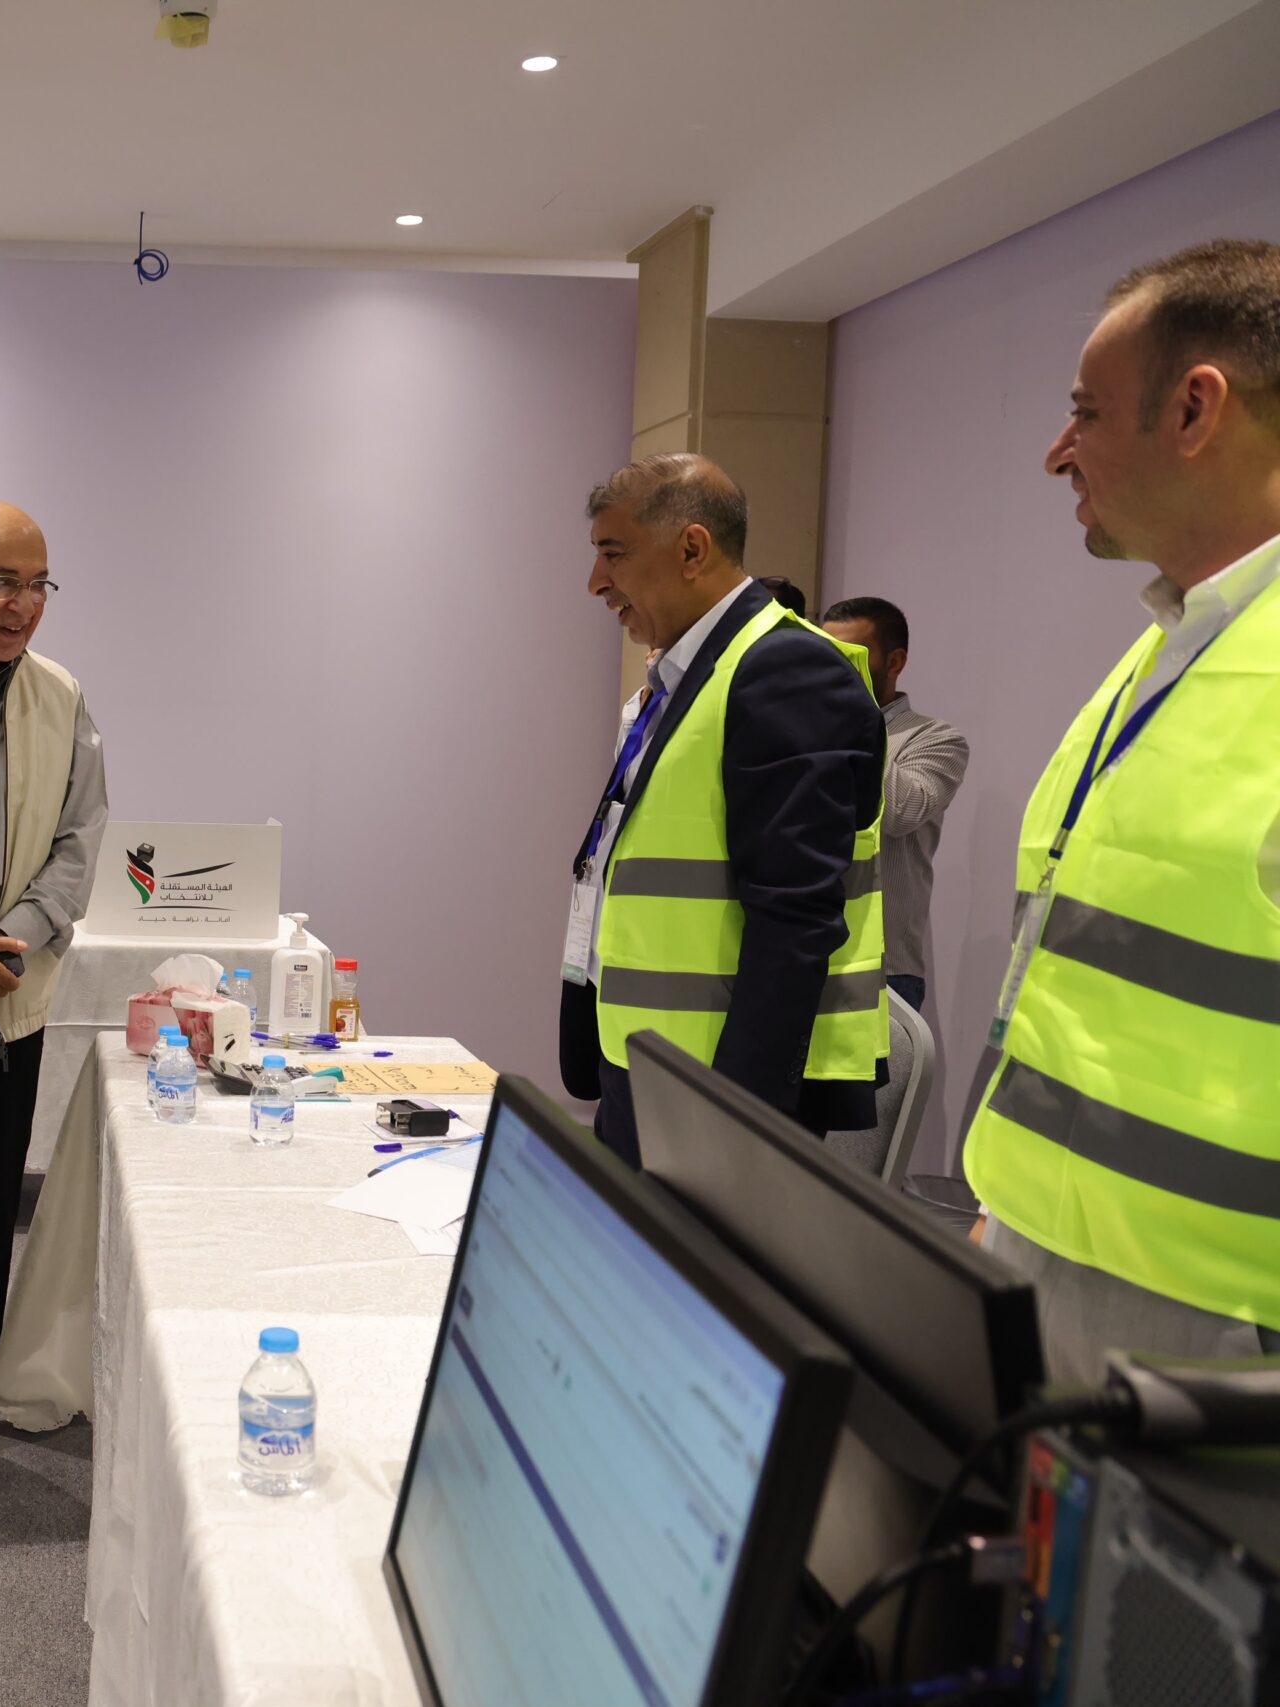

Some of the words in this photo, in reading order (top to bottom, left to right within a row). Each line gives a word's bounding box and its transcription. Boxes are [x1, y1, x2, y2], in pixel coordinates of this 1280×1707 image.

[159, 882, 206, 891] المستقلة
[206, 882, 233, 893] الهيئة
[159, 892, 214, 903] للانتخاب
